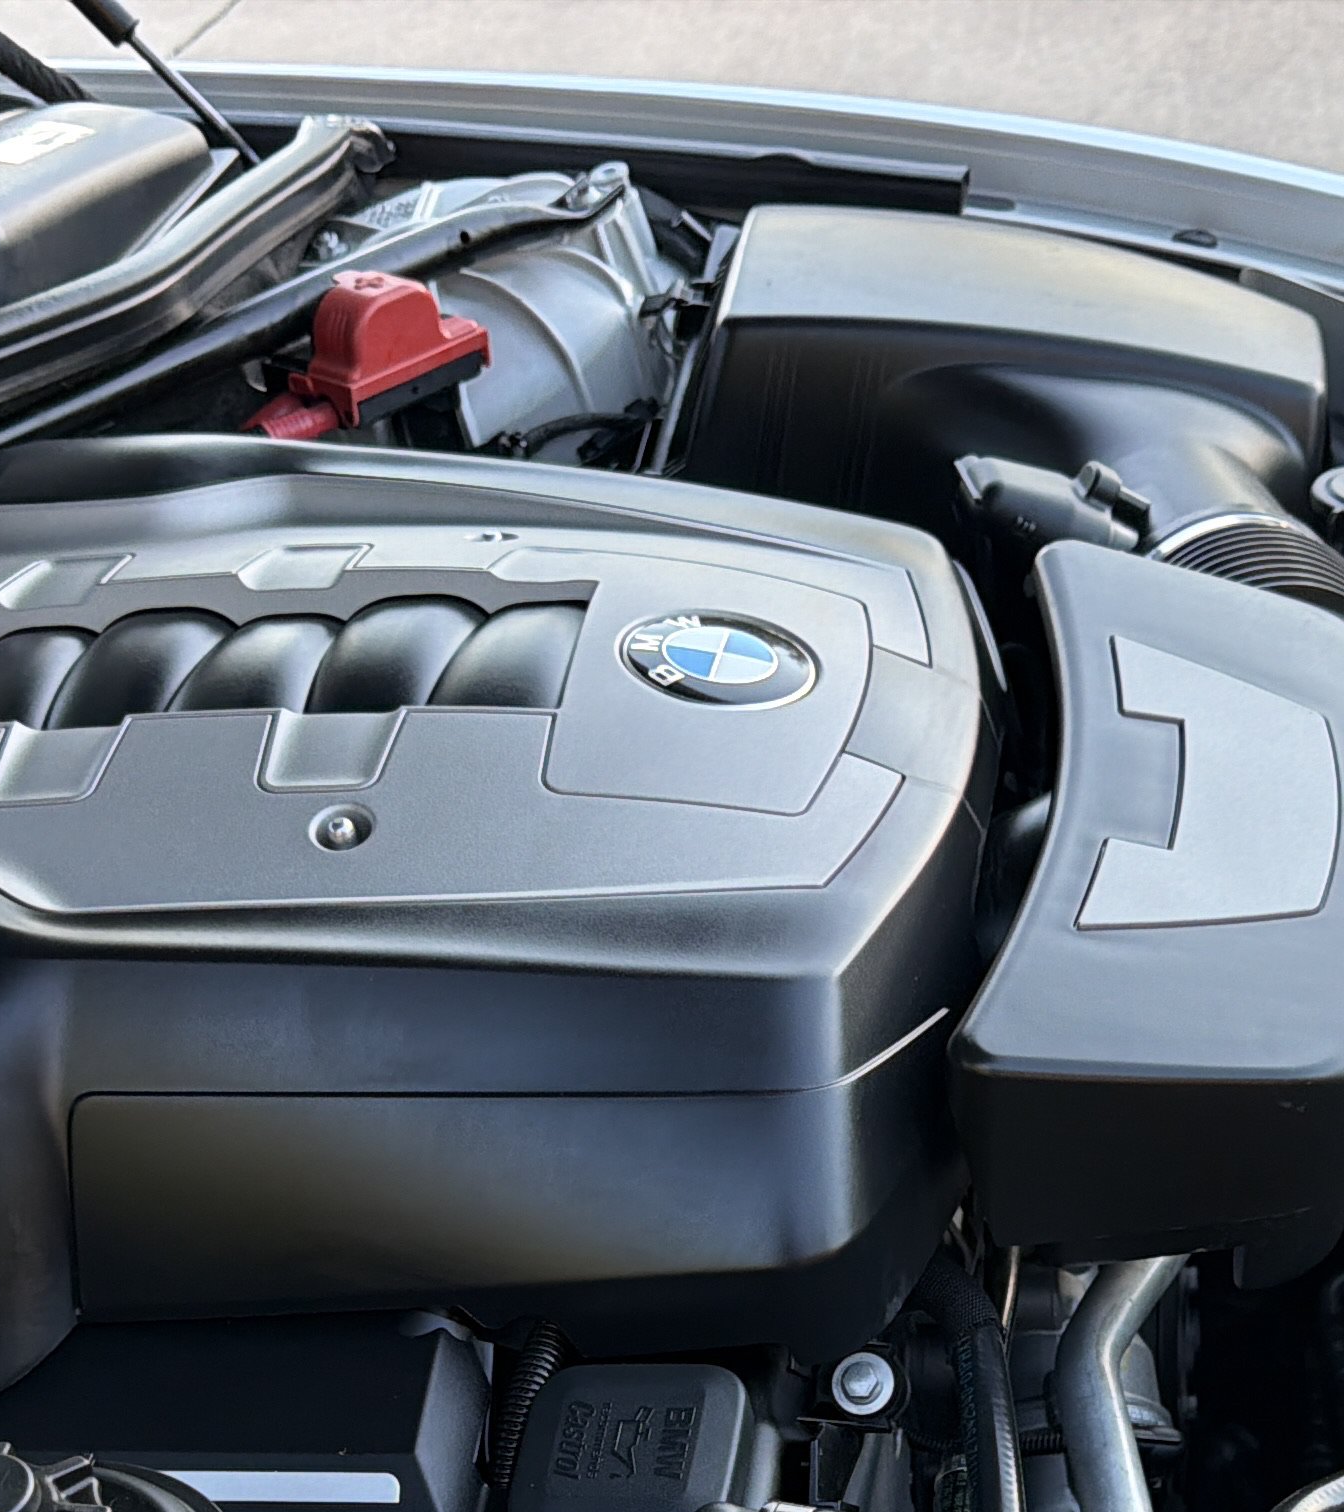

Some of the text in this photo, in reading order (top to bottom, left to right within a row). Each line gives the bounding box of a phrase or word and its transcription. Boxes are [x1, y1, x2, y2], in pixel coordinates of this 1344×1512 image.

[631, 616, 701, 686] BMW
[553, 1399, 595, 1481] Castrol
[653, 1406, 698, 1481] BMW
